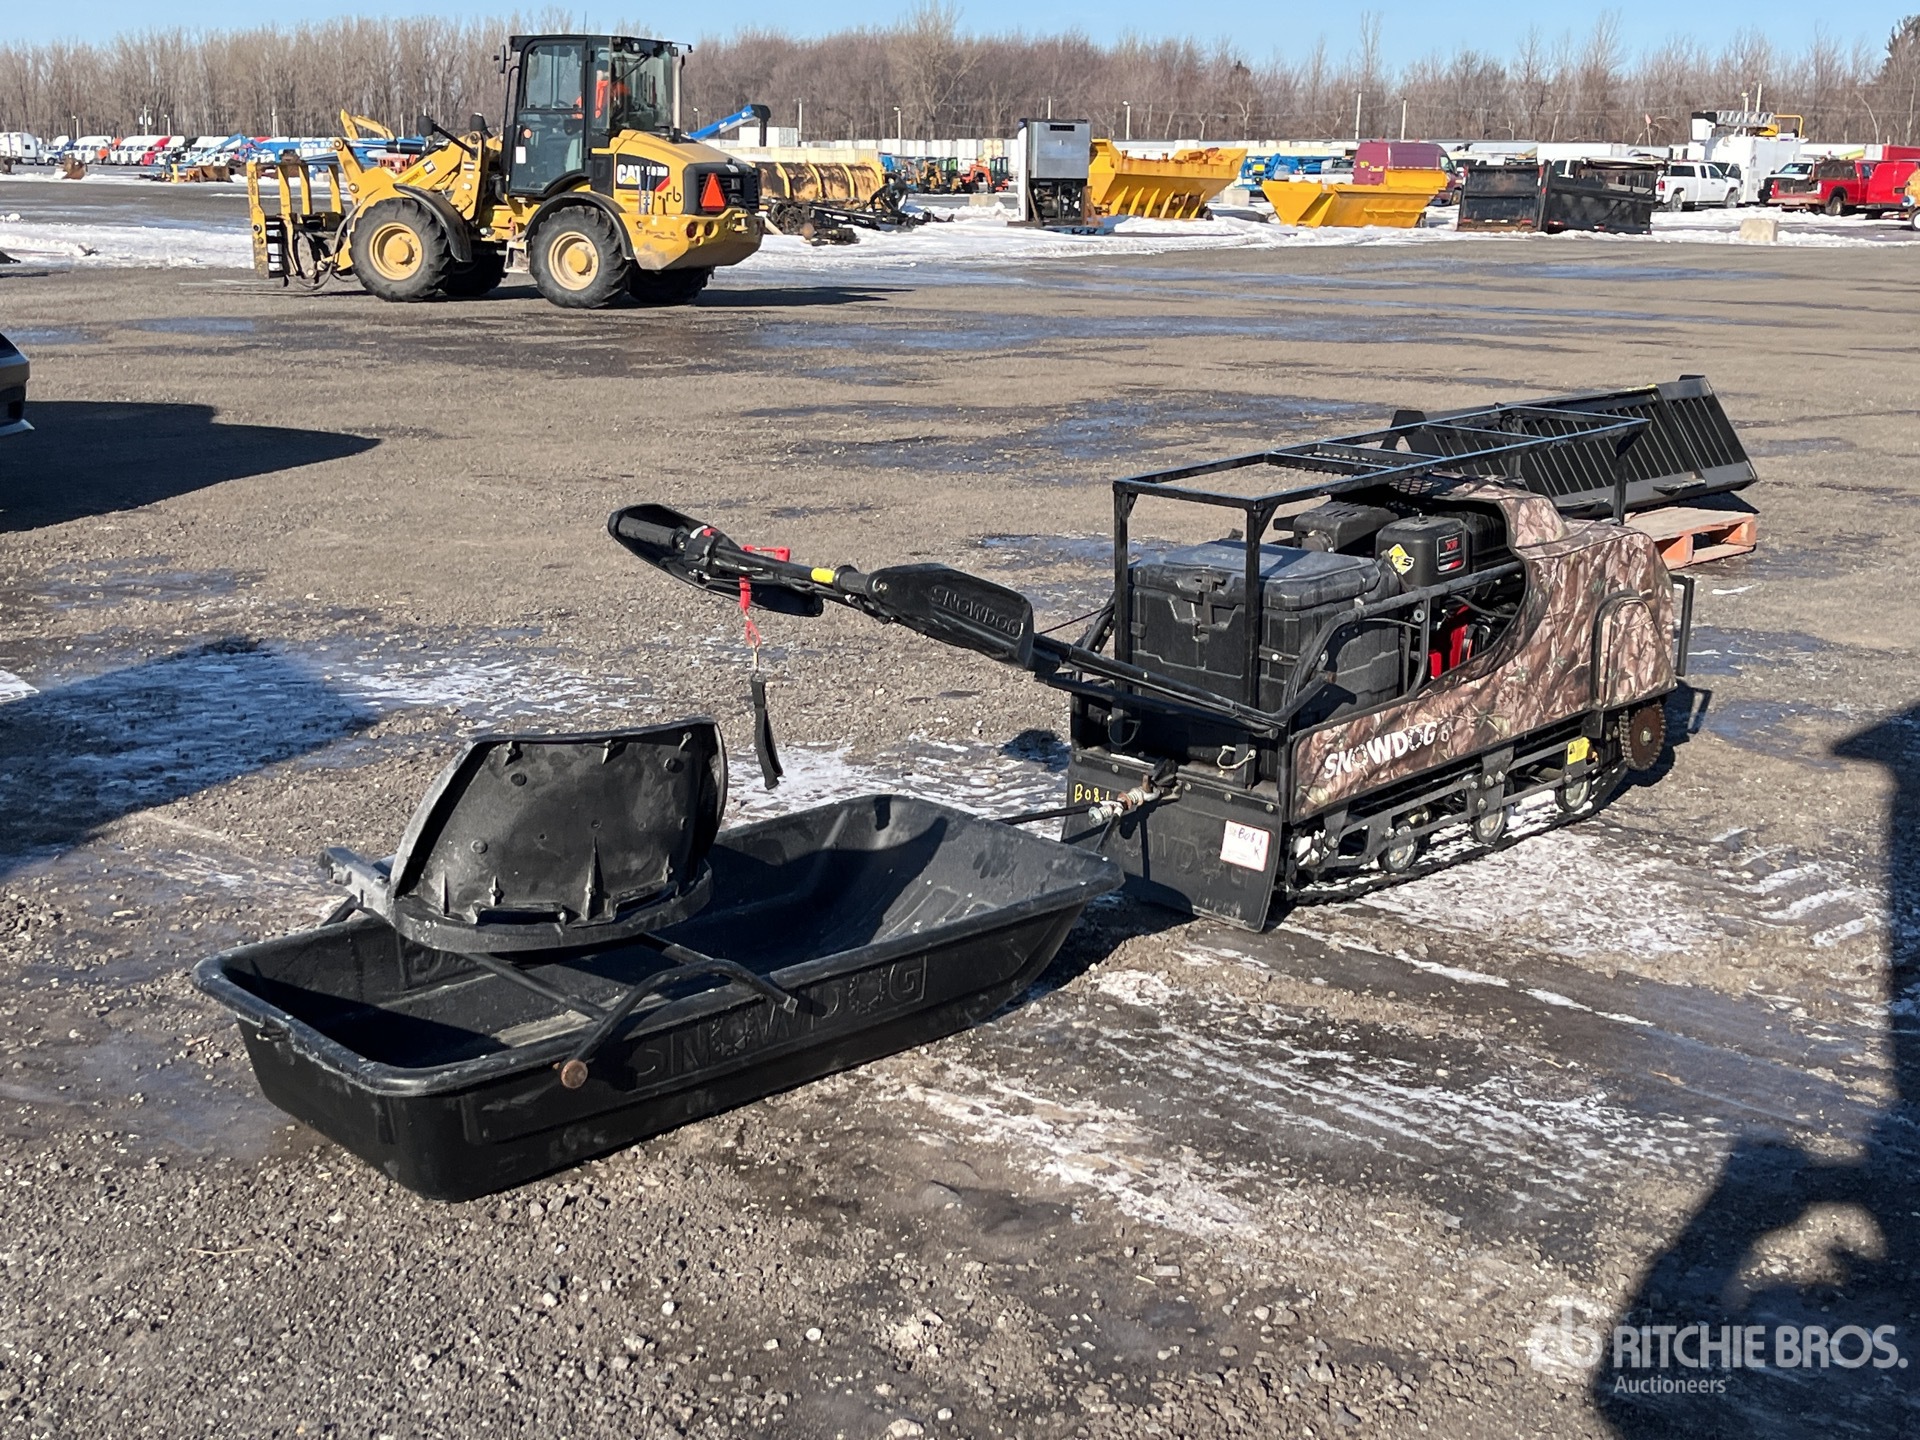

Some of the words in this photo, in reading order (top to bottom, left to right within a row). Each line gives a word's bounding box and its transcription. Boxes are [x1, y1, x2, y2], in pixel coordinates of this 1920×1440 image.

[617, 164, 644, 184] CAT
[666, 186, 682, 203] rb
[930, 585, 1018, 635] SNOWDOG
[1323, 721, 1438, 779] SNOWDOG
